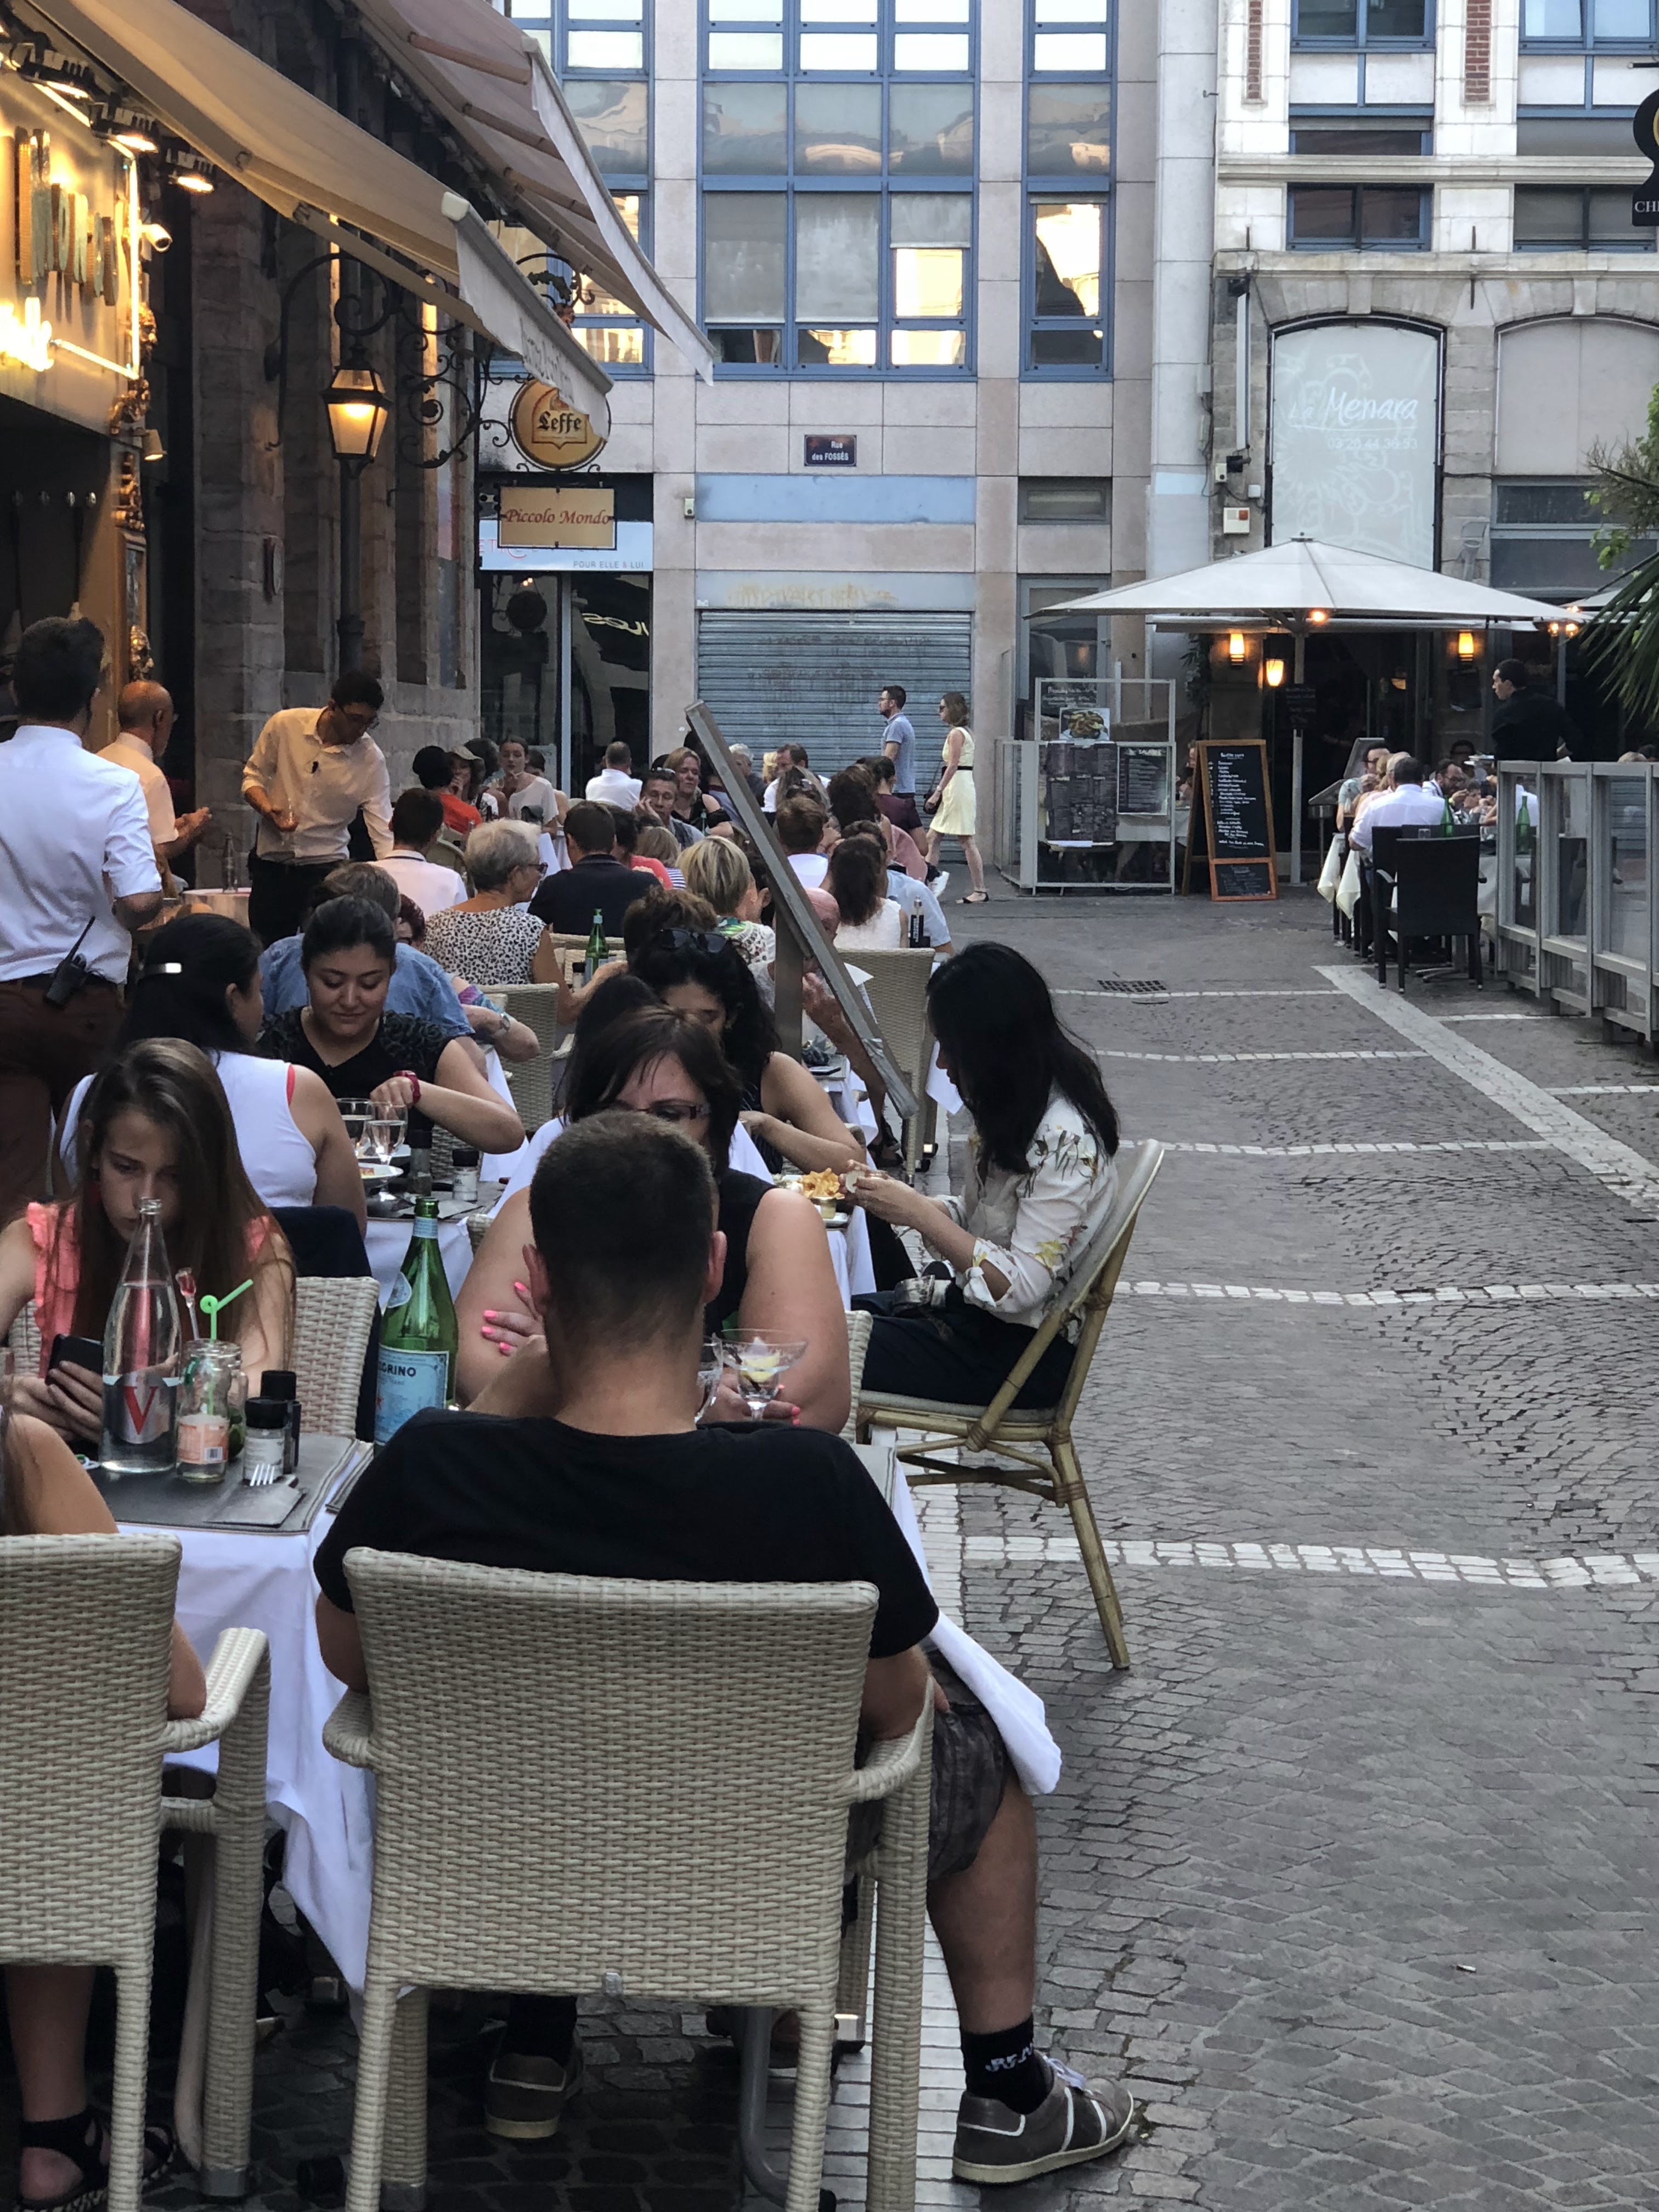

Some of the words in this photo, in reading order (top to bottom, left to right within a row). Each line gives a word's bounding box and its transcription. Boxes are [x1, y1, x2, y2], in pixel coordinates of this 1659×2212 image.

[1289, 401, 1313, 420] La
[1321, 386, 1419, 426] Menara
[537, 410, 582, 434] Leffe
[831, 441, 843, 449] Rue
[812, 453, 823, 461] des
[506, 508, 555, 523] Piccolo
[559, 509, 610, 524] Mondo
[630, 561, 644, 569] LUI
[122, 1385, 159, 1435] V
